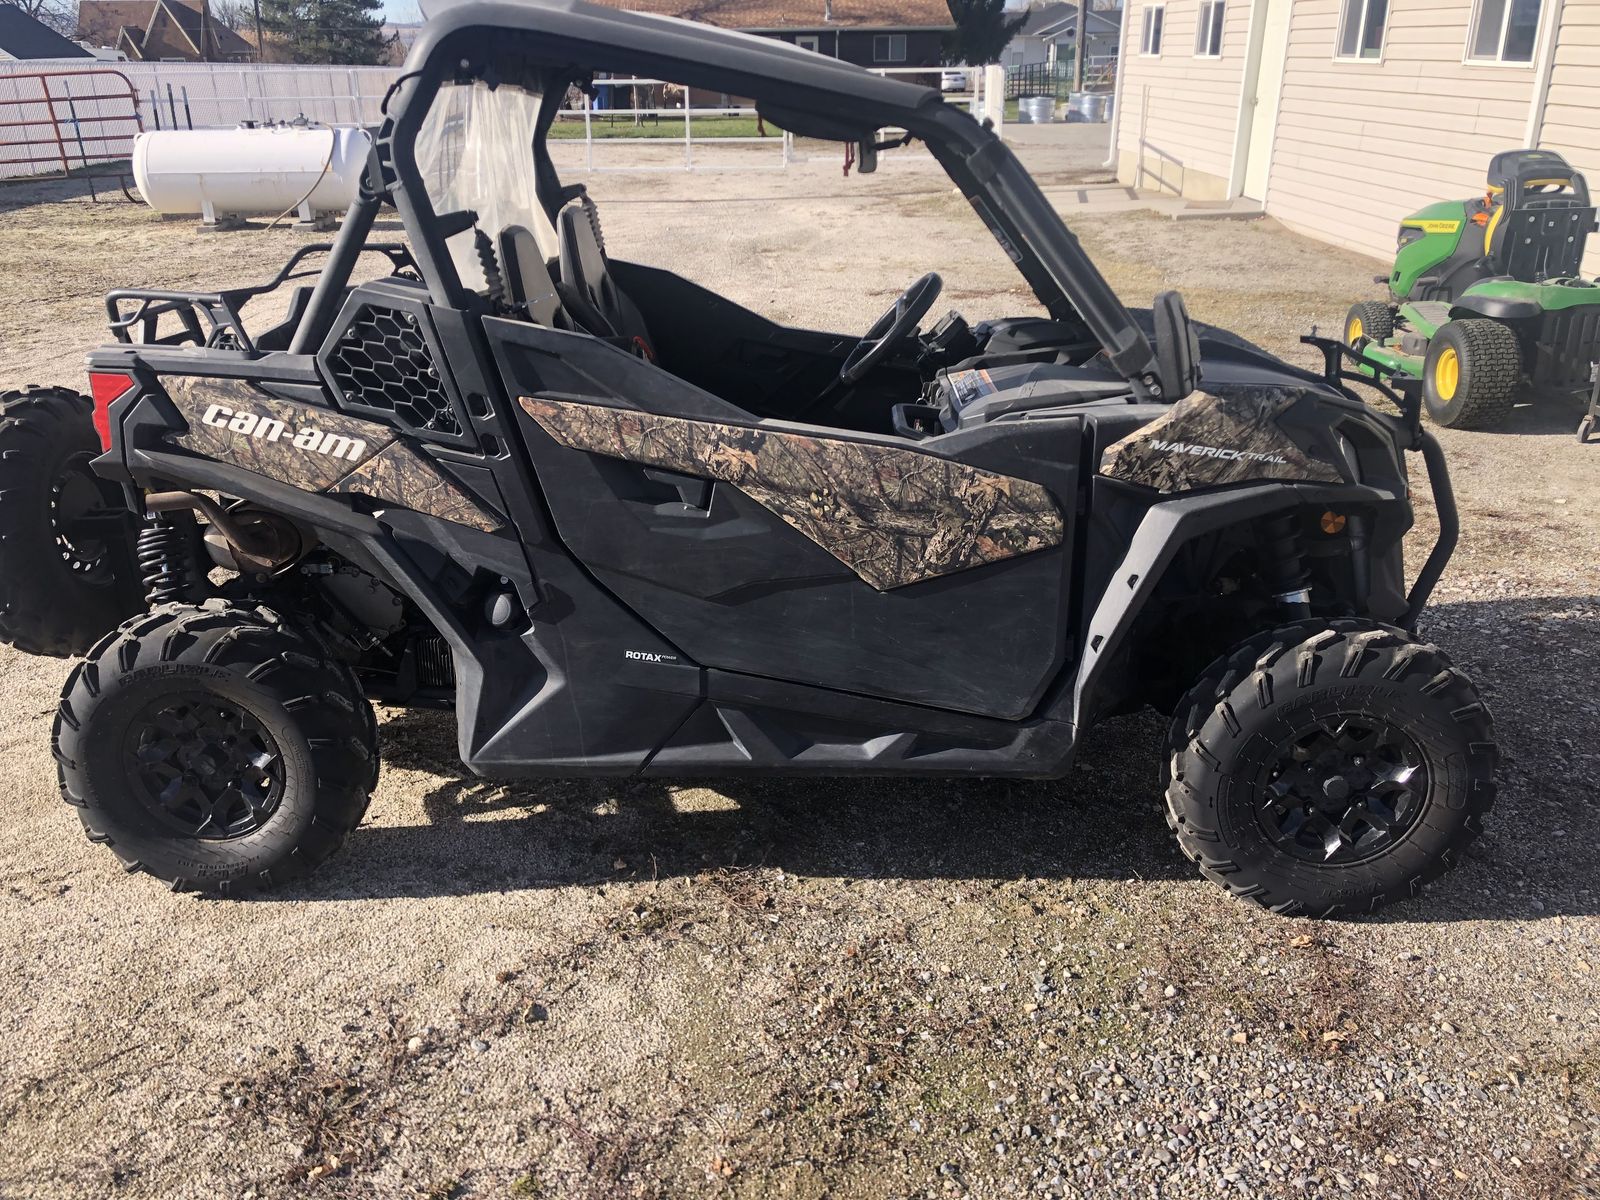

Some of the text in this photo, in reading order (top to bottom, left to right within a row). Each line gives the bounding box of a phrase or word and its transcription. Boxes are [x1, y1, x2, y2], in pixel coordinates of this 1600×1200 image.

[202, 404, 367, 461] can-am
[1150, 439, 1287, 464] MAVERICK TRAIL
[625, 650, 662, 662] ROTAX
